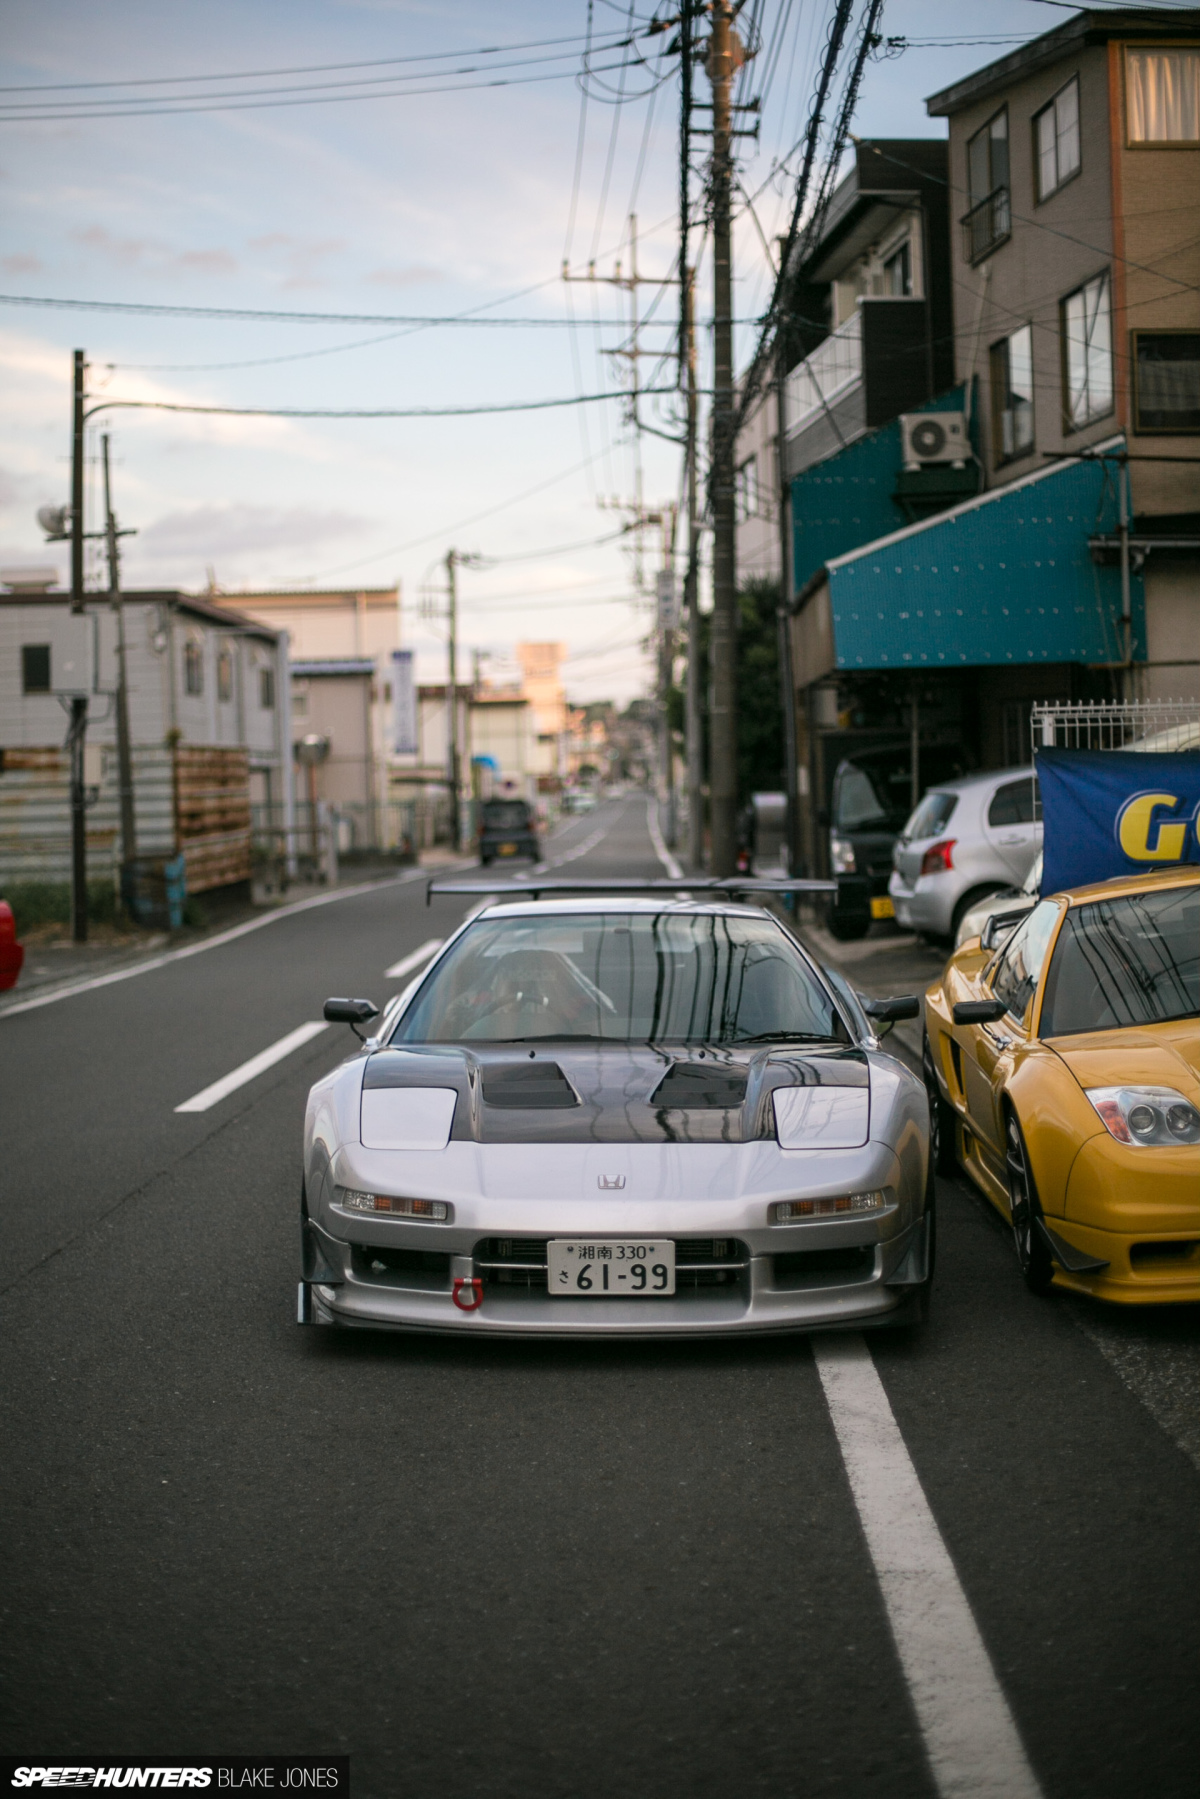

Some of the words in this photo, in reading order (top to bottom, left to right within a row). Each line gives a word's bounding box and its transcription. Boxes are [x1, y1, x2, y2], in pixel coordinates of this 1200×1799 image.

[1114, 788, 1200, 862] G
[578, 1245, 613, 1260] 湘南
[615, 1245, 647, 1260] 330
[558, 1269, 569, 1284] さ
[576, 1263, 668, 1291] 61-99
